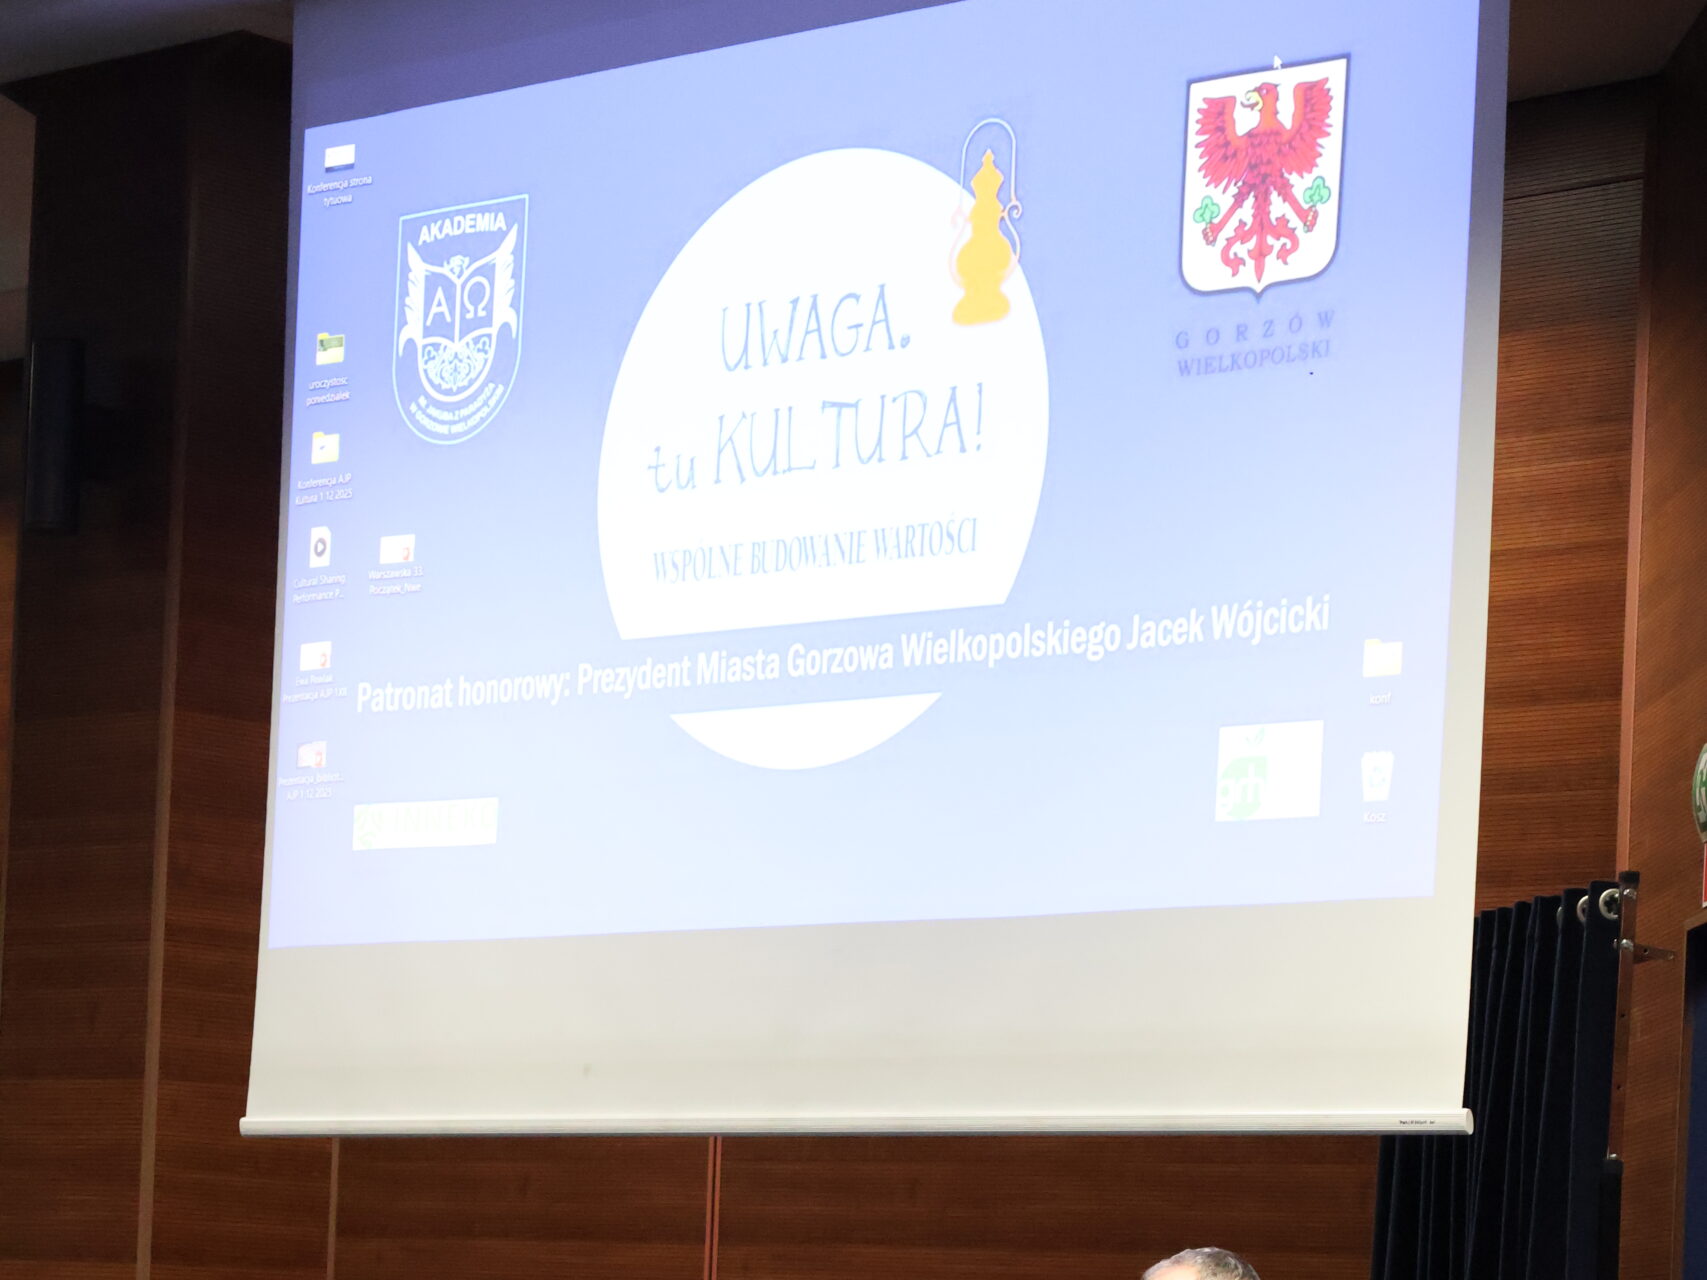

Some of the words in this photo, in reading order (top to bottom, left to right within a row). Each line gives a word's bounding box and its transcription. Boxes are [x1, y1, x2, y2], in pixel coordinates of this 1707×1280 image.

[349, 176, 373, 188] strona
[418, 211, 508, 246] AKADEMIA
[720, 283, 912, 373] UWAGA.
[1177, 339, 1332, 377] WIELKOPOLSKI
[646, 445, 697, 494] tu
[712, 382, 984, 485] KULTURA!
[652, 538, 744, 585] WSPÓLNE
[750, 528, 868, 577] BUDOWANIE
[872, 512, 979, 564] WARTOŚCI
[357, 677, 454, 713] Patronat
[458, 671, 571, 706] honorowy:
[577, 657, 692, 701] Prezydent
[696, 646, 782, 686] Miasta
[787, 642, 894, 678] Gorzowa
[900, 618, 1122, 668] Wielkopolskiego
[1126, 608, 1205, 650] Jacek
[1210, 594, 1330, 646] Wójcicki
